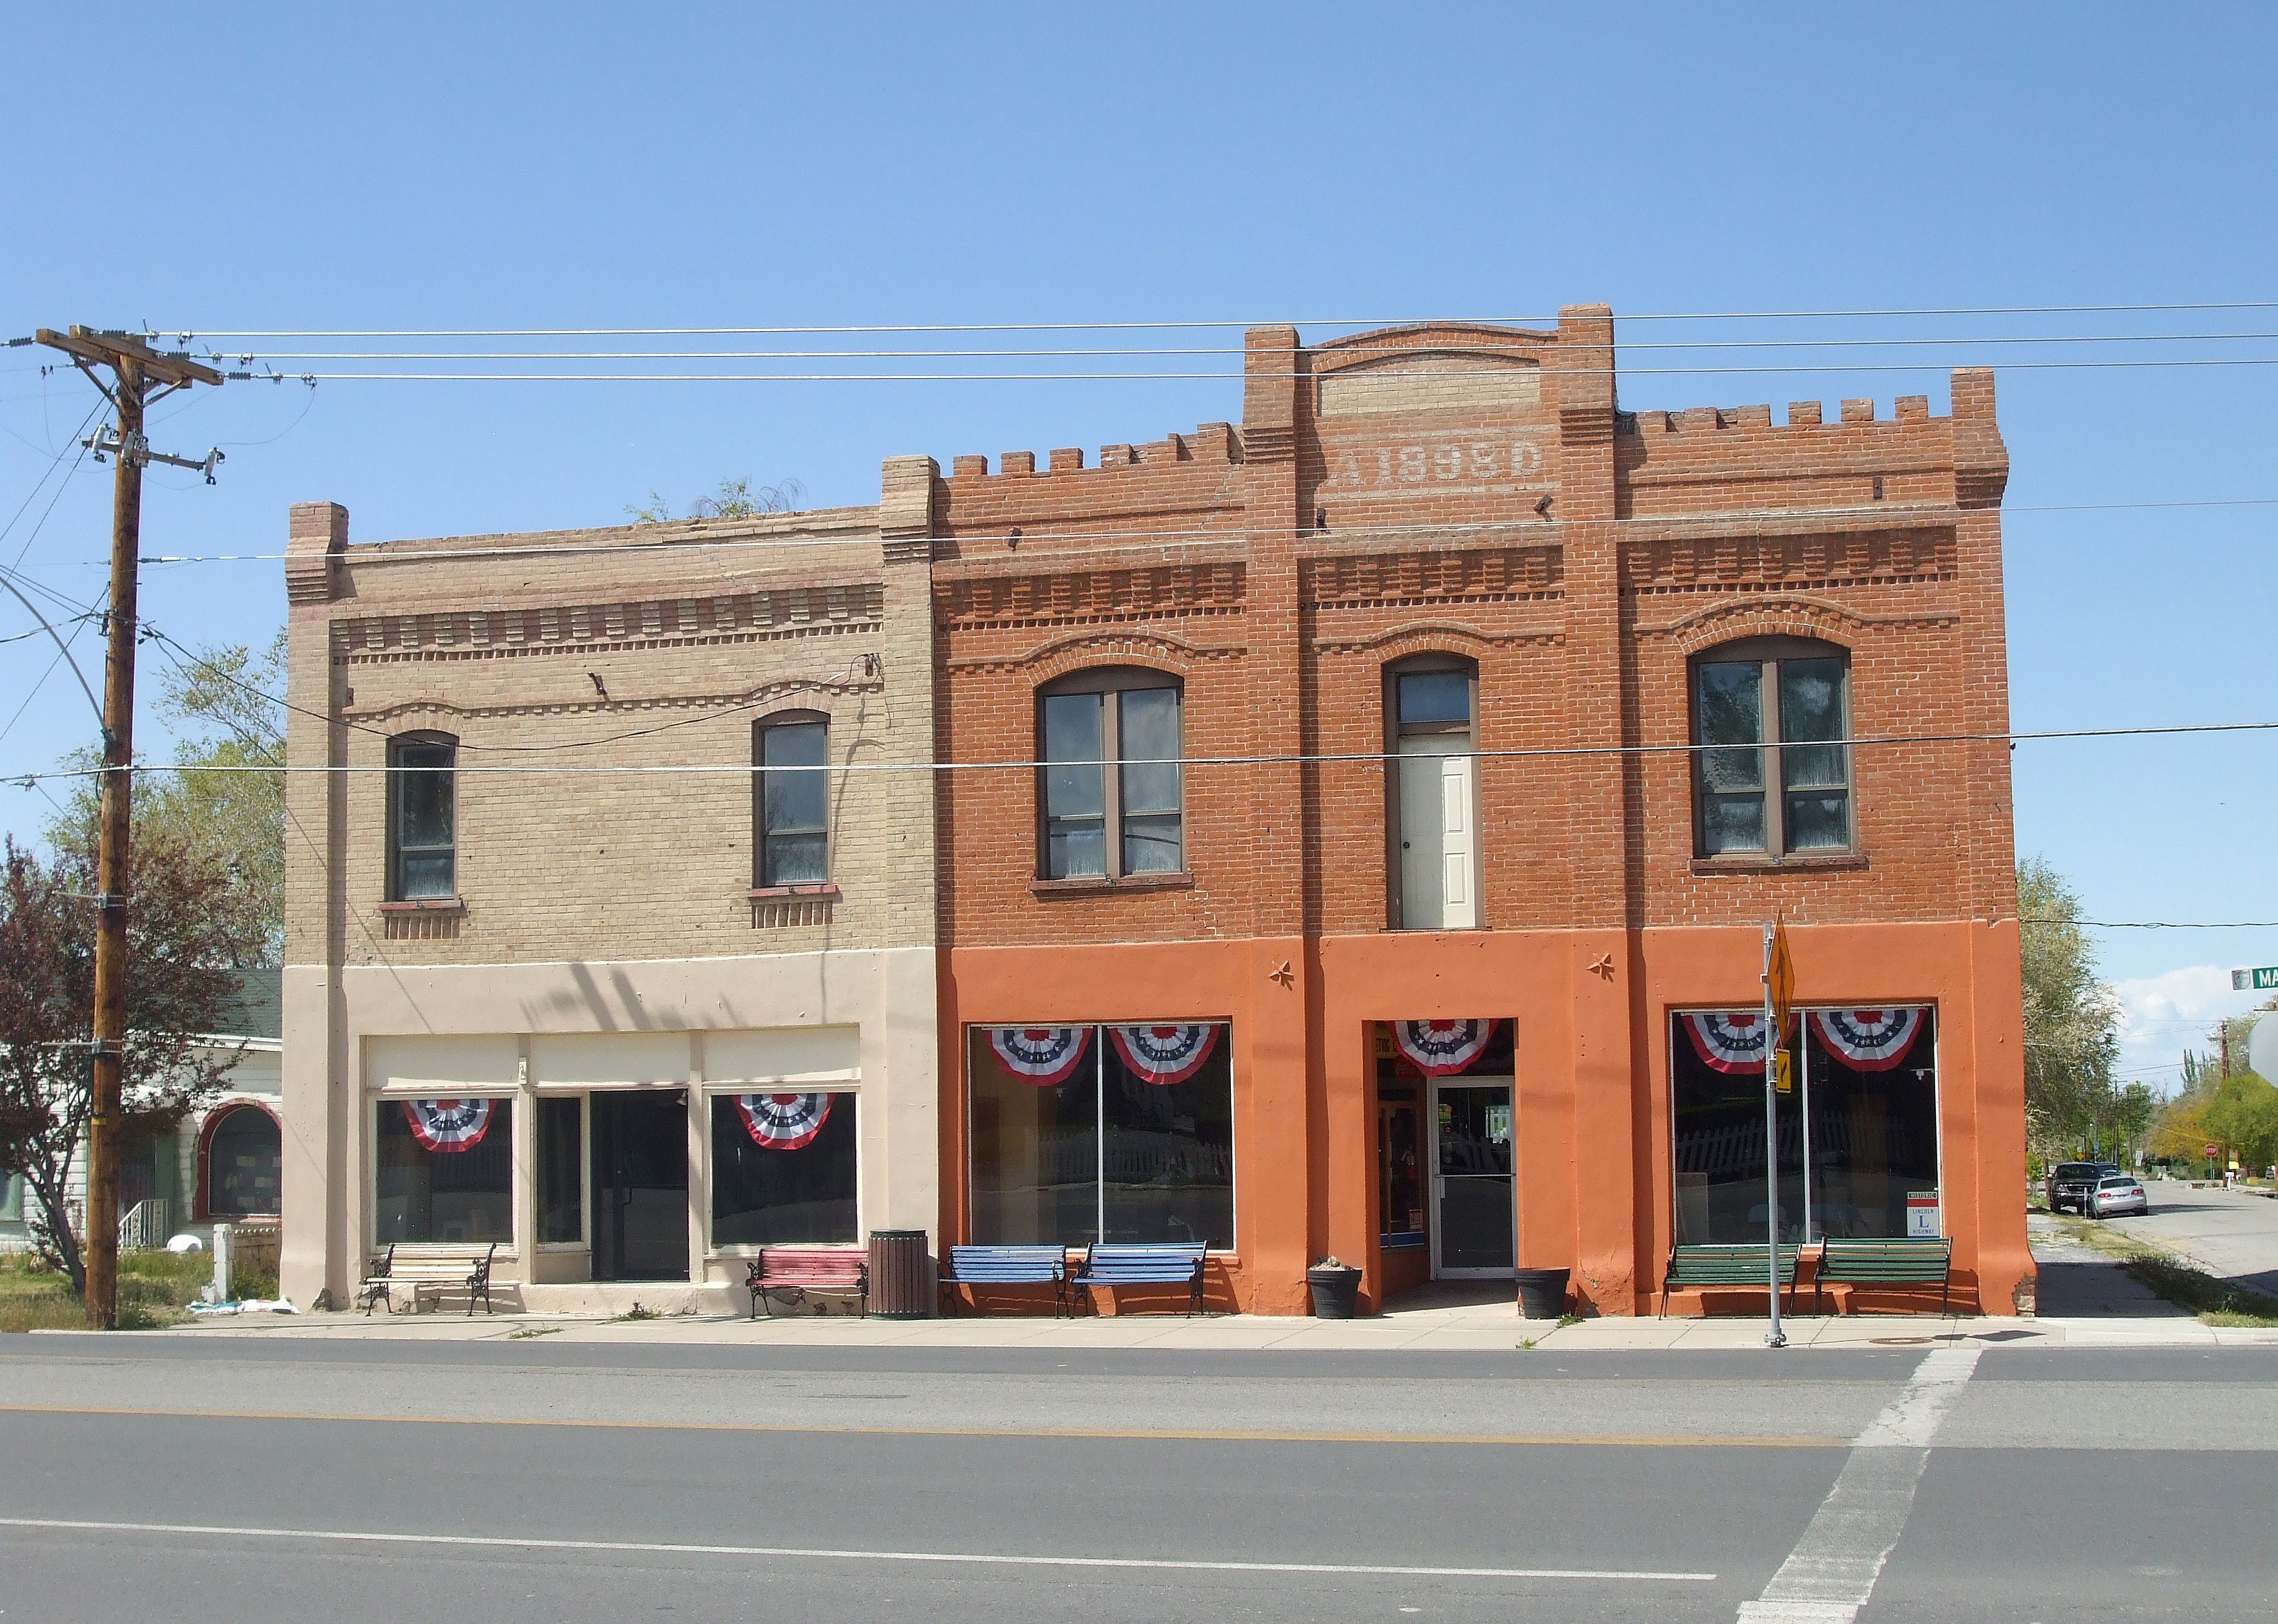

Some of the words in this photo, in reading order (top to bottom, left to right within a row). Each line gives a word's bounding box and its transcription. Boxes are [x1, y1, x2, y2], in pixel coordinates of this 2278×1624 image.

[1326, 449, 1364, 485] A
[1511, 441, 1543, 478] D
[1918, 1216, 1930, 1228] L
